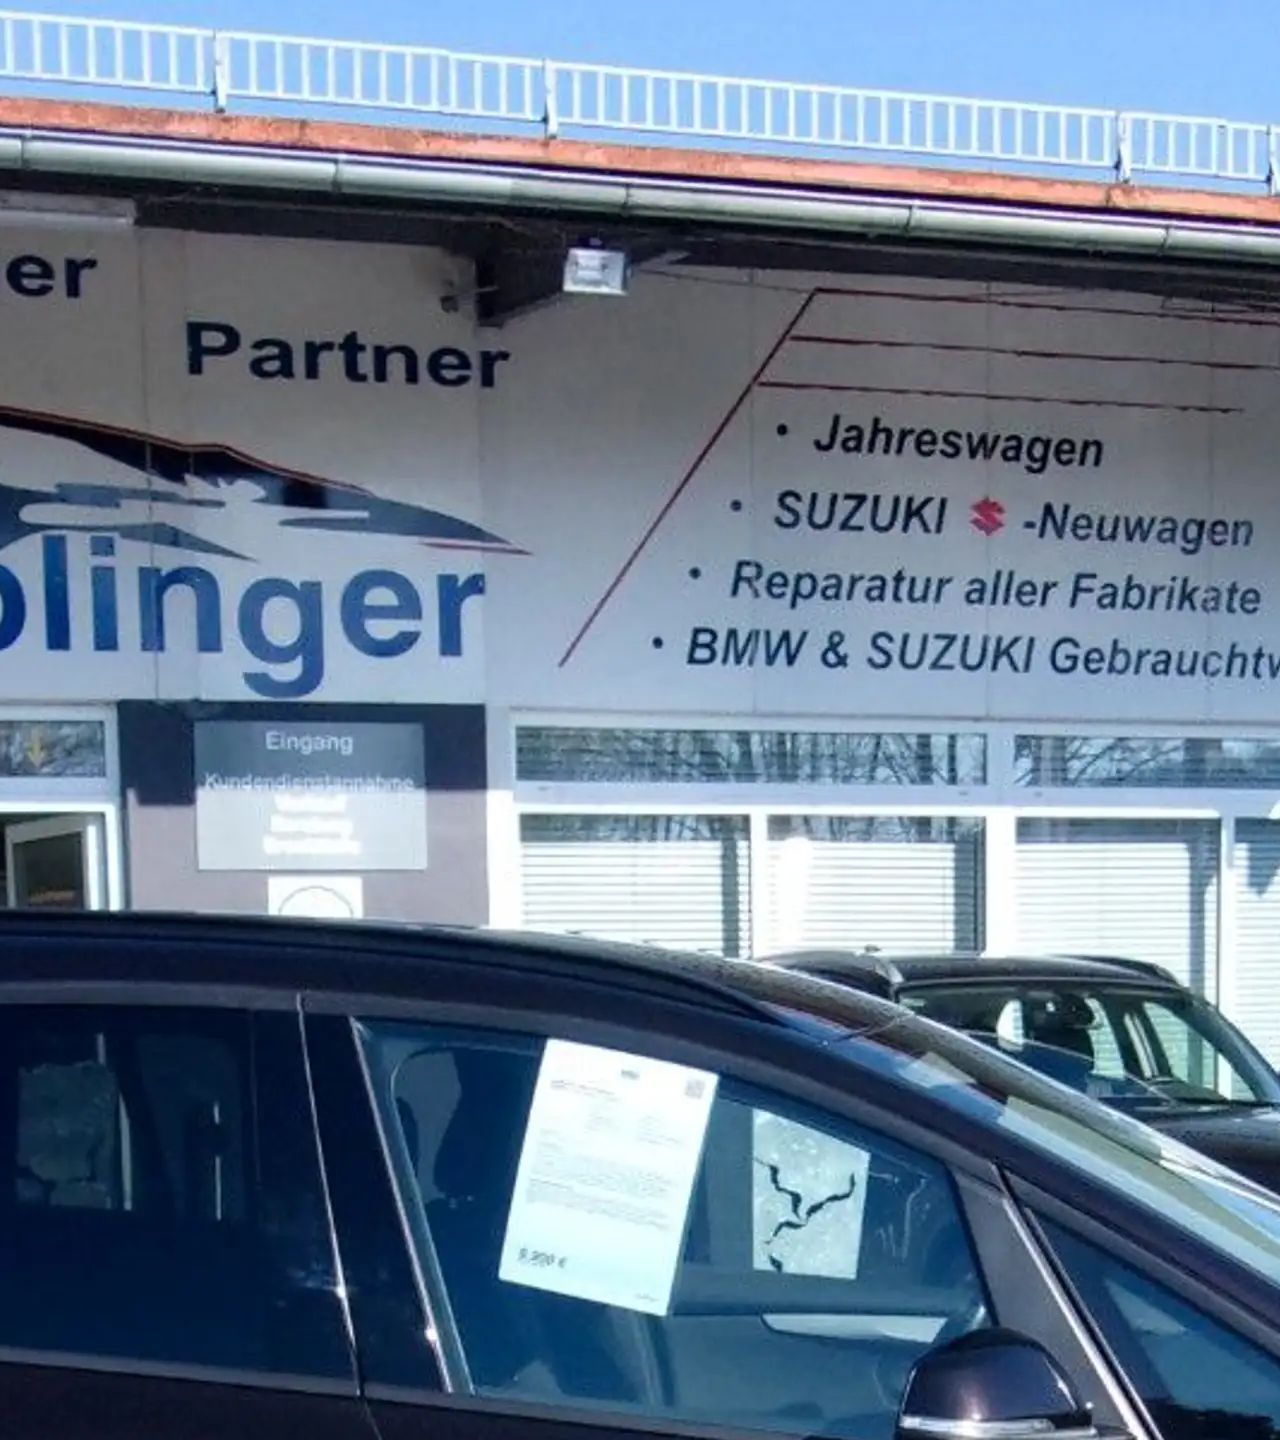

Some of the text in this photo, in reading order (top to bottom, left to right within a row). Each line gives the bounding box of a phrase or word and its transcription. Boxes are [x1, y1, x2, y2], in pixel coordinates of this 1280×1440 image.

[185, 321, 511, 389] Partner
[812, 413, 1104, 475] Jahreswagen
[773, 489, 1254, 556] SUZUKI -Neuwagen
[730, 559, 1262, 615] Reparatur aller Fabrikate
[685, 626, 809, 668] BMW
[819, 629, 850, 670] &
[865, 630, 1036, 674] SUZUKI
[265, 730, 354, 755] Eingang
